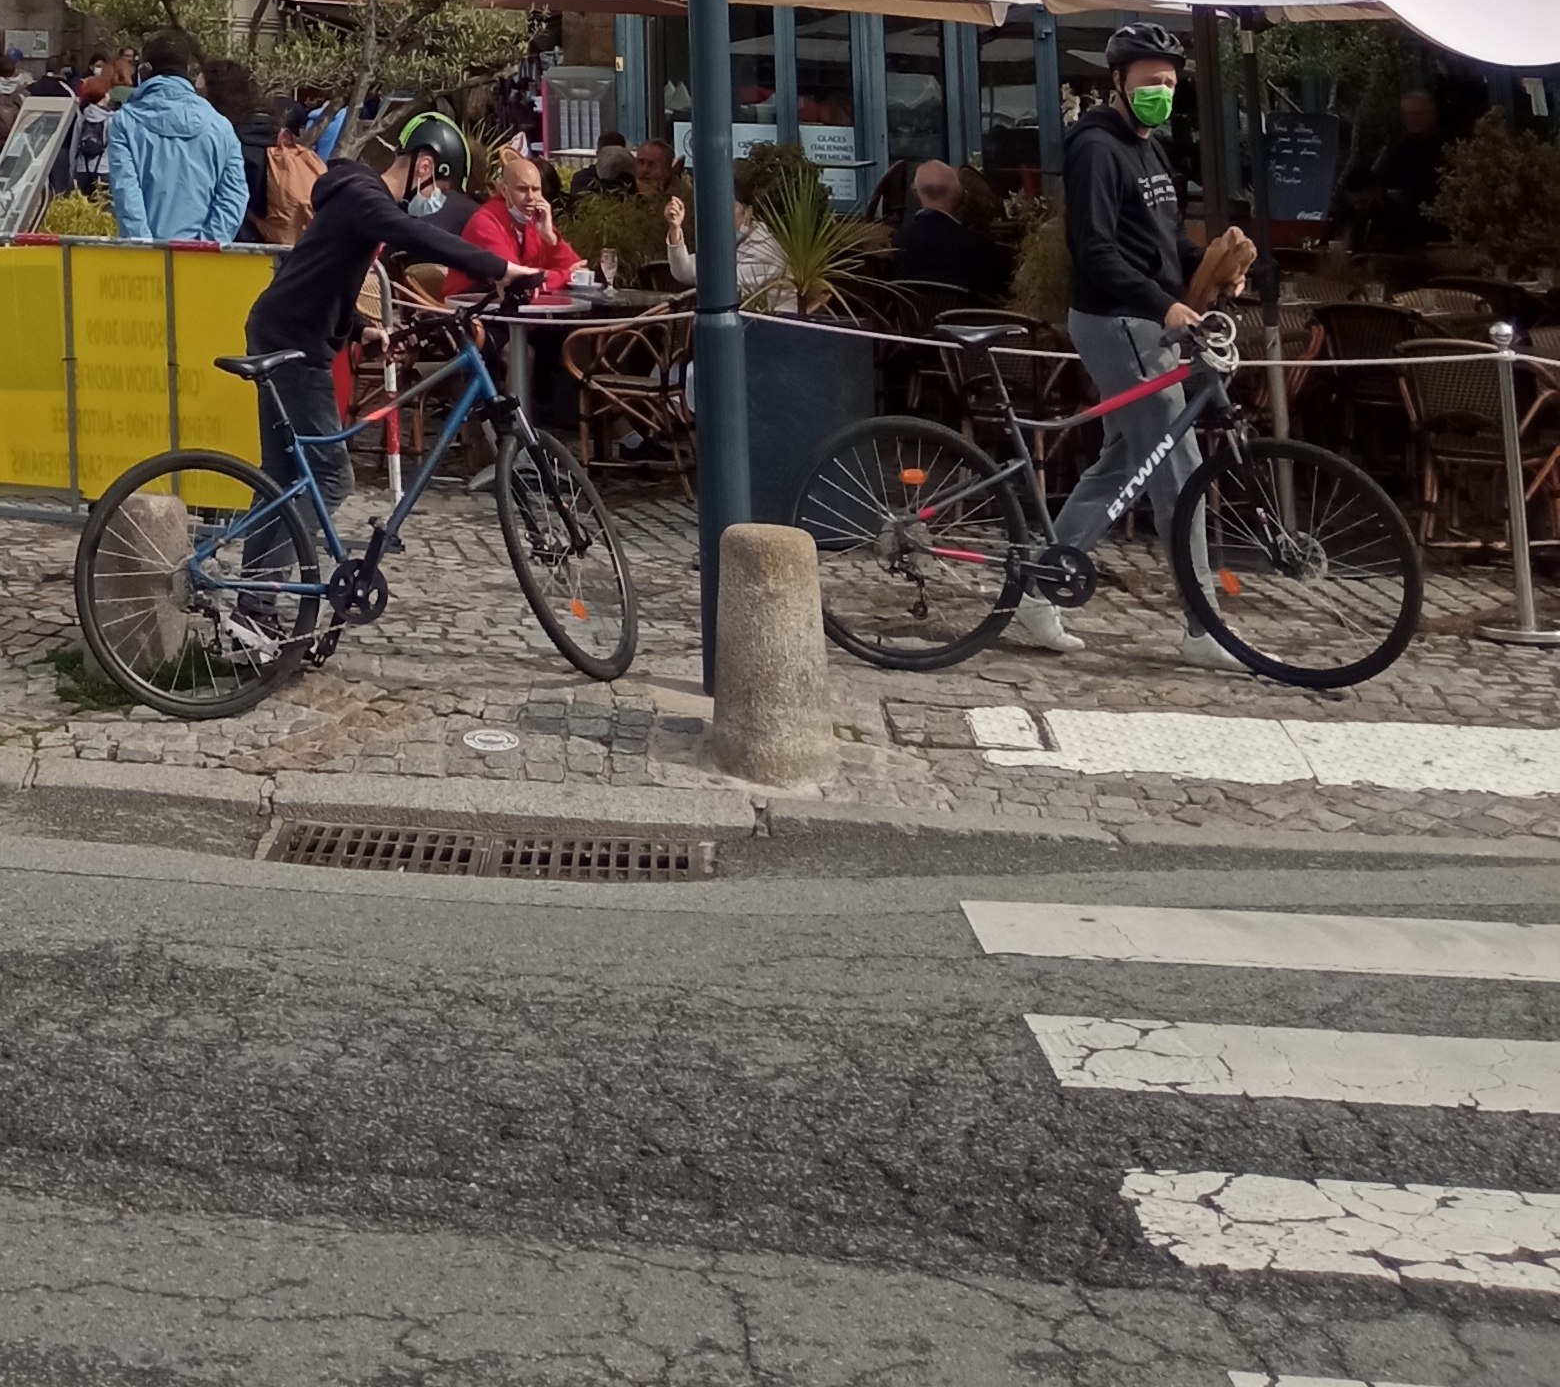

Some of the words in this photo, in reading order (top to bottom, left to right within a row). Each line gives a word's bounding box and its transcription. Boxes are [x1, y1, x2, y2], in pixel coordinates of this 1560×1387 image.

[817, 135, 847, 143] GLACES
[810, 144, 854, 152] ITALIENNES
[814, 153, 852, 161] PREMIUM
